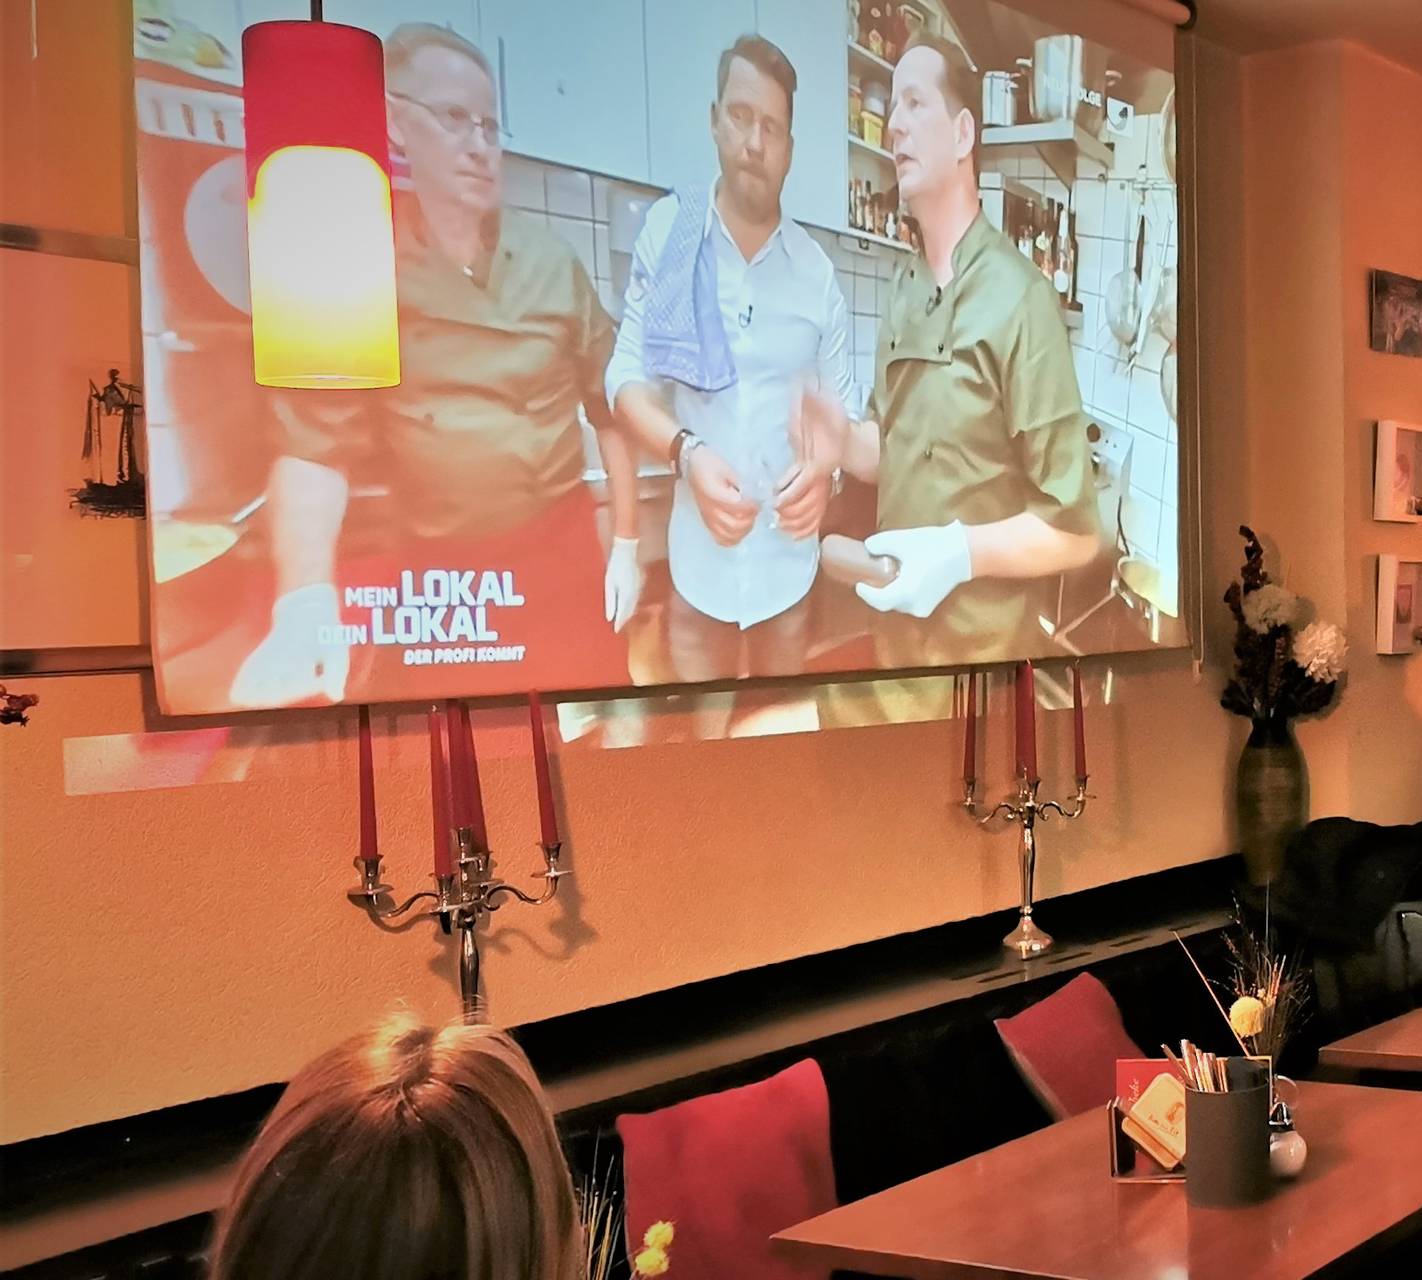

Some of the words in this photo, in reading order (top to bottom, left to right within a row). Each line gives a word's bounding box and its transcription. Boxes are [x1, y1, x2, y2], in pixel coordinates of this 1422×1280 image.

[344, 587, 398, 608] MEIN
[401, 569, 525, 607] LOKAL
[317, 624, 367, 645] DEIN
[371, 605, 499, 645] LOKAL
[403, 648, 433, 665] DER
[433, 647, 476, 664] PROFI
[476, 645, 526, 662] KOMMT
